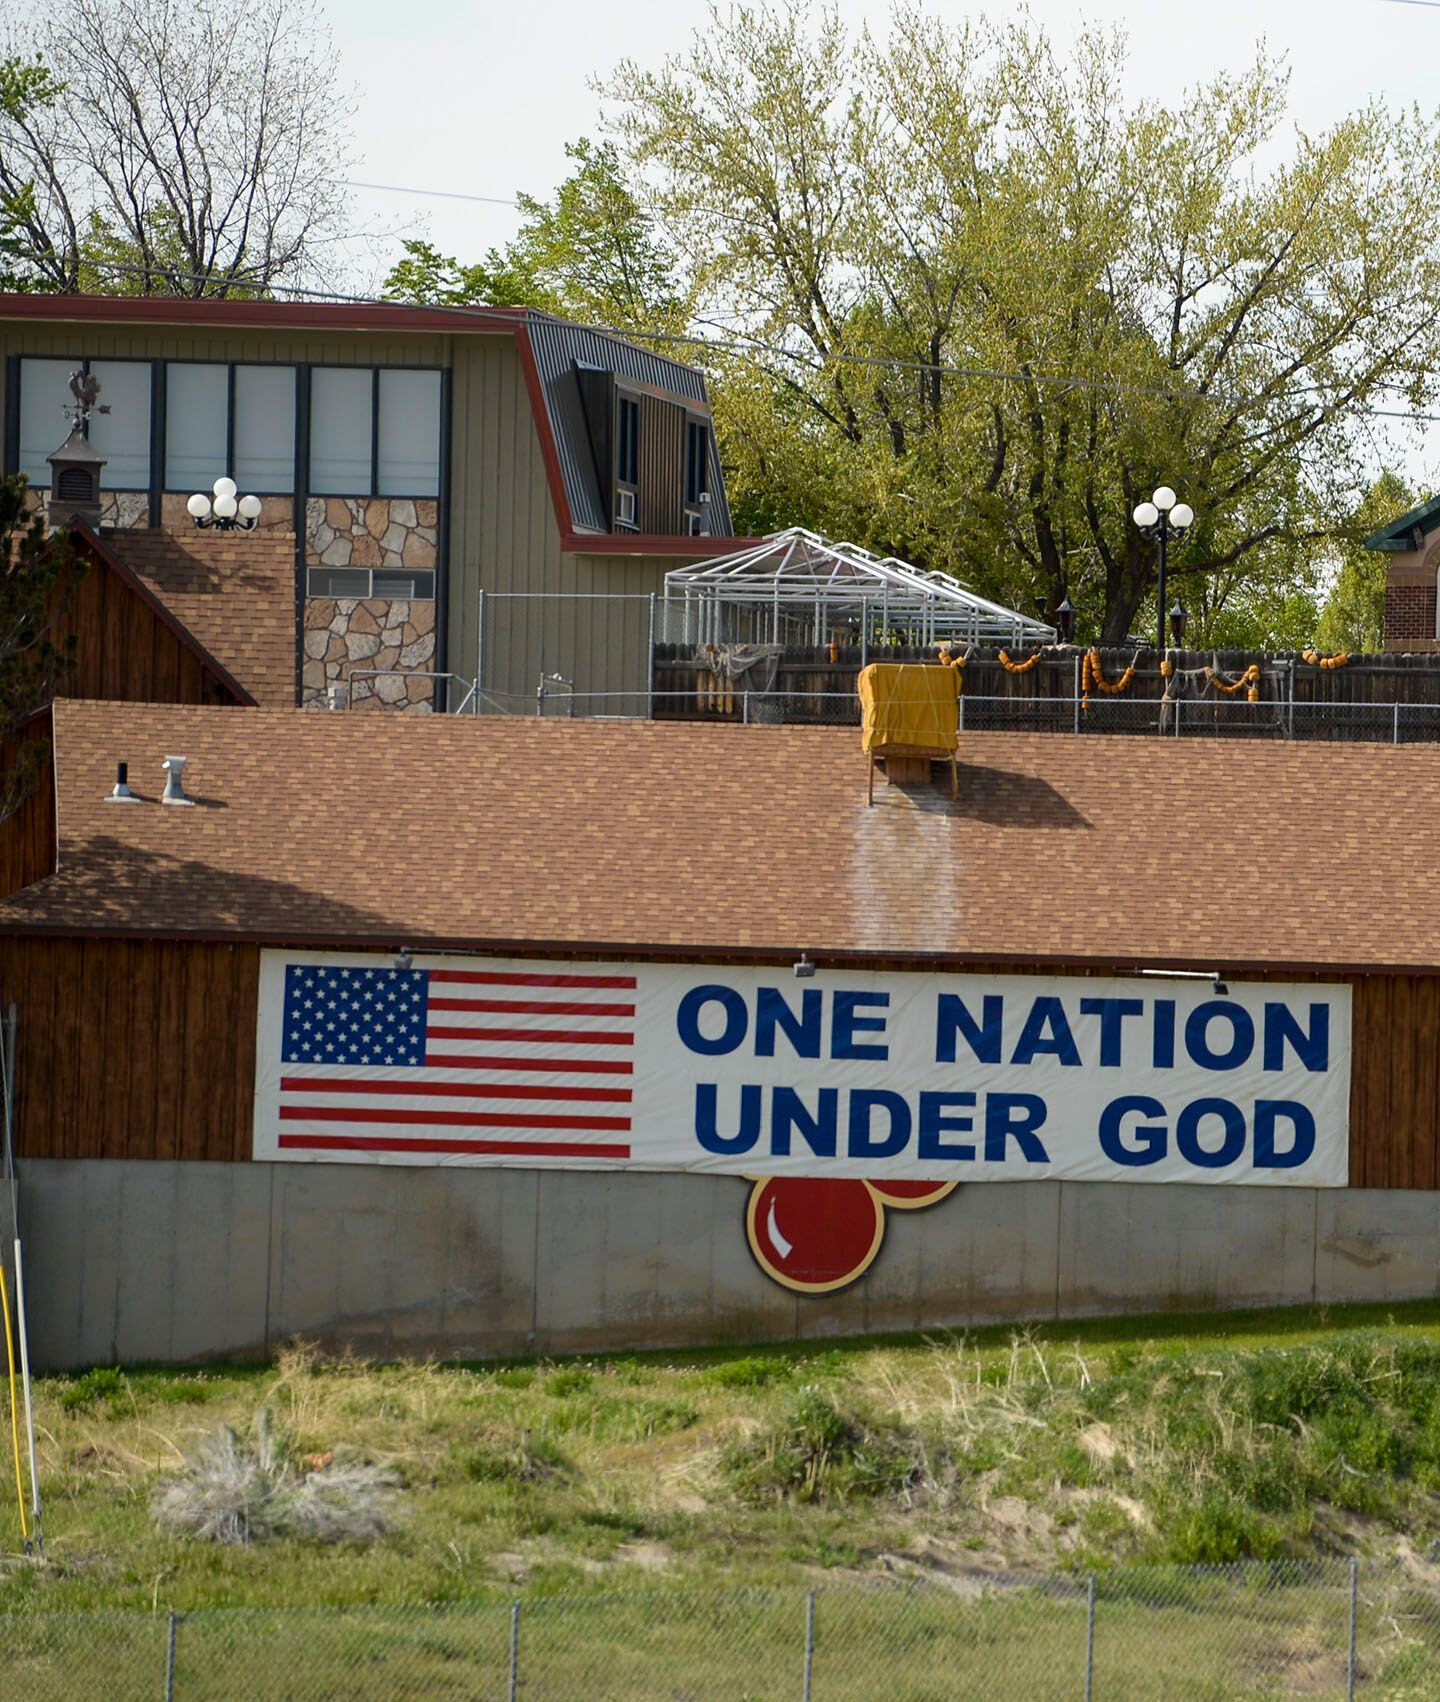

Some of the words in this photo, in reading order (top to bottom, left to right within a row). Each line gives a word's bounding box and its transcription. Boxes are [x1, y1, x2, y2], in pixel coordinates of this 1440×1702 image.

[676, 984, 890, 1061] ONE
[935, 993, 1330, 1072] NATION
[695, 1083, 1051, 1163] UNDER
[1098, 1095, 1316, 1169] GOD
